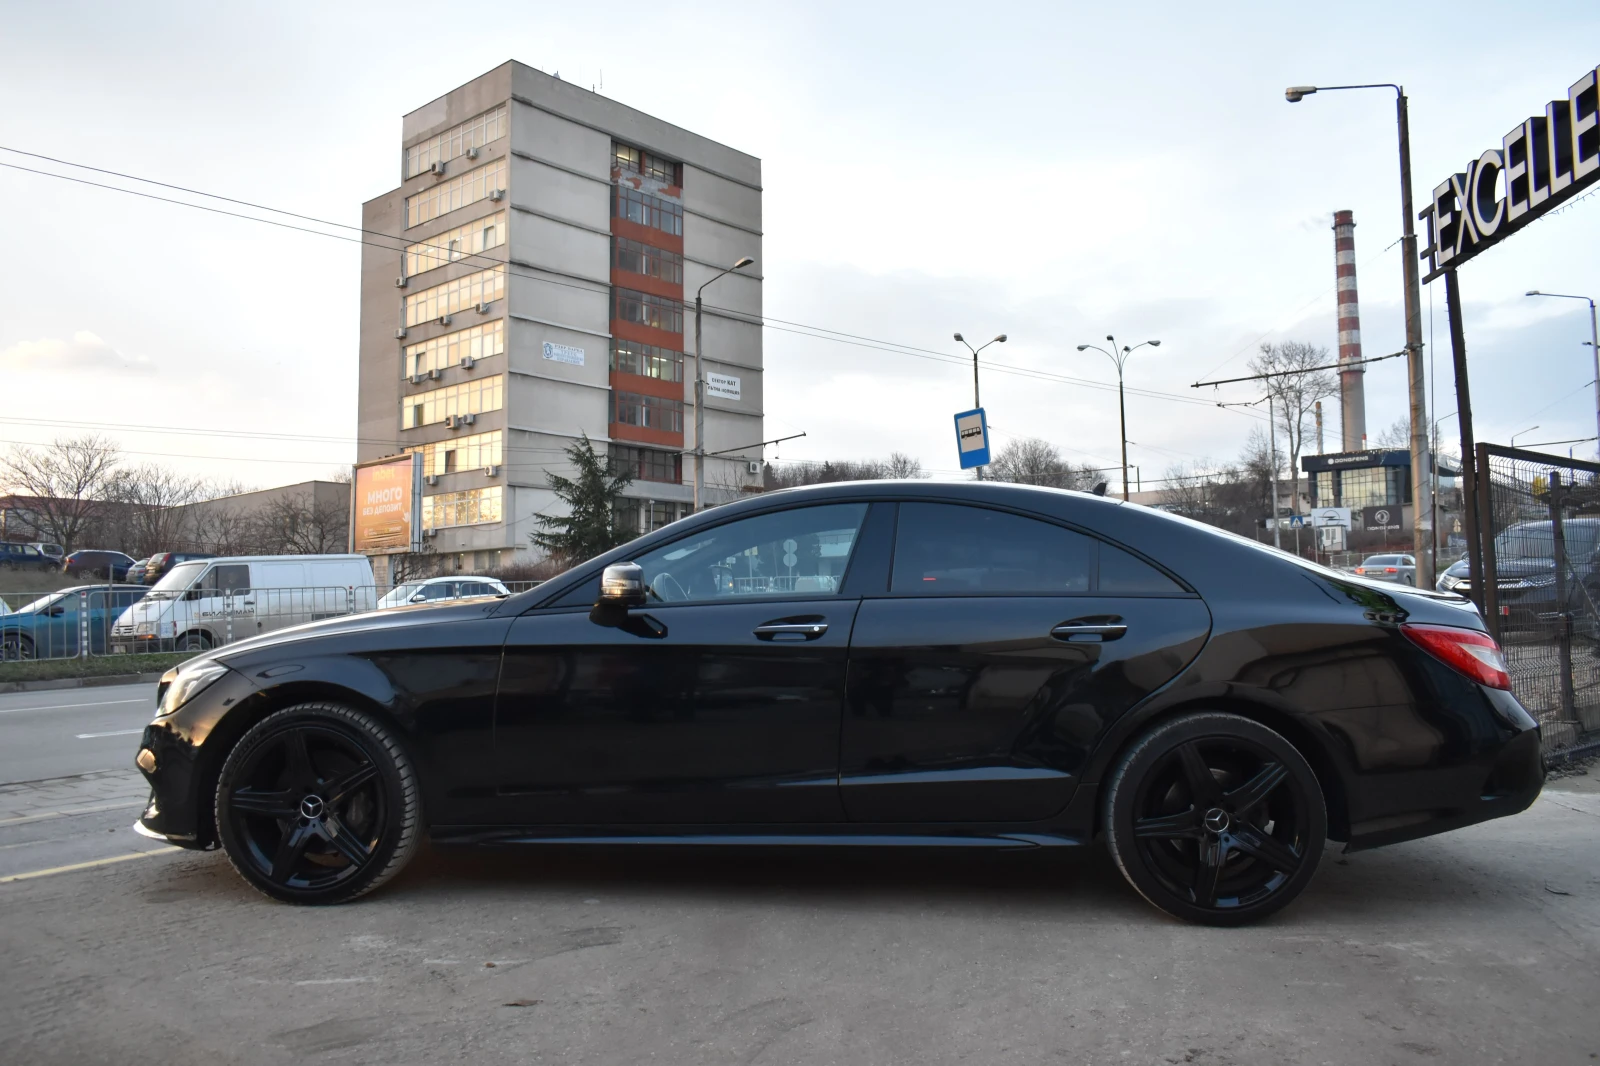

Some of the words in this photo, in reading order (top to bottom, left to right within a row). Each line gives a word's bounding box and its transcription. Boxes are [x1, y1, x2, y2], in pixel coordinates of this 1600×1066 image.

[1432, 64, 1600, 266] EXCELLE
[367, 487, 402, 504] МНОГО
[363, 506, 373, 515] БЕЗ
[374, 503, 402, 515] ДЕПОЗИТ
